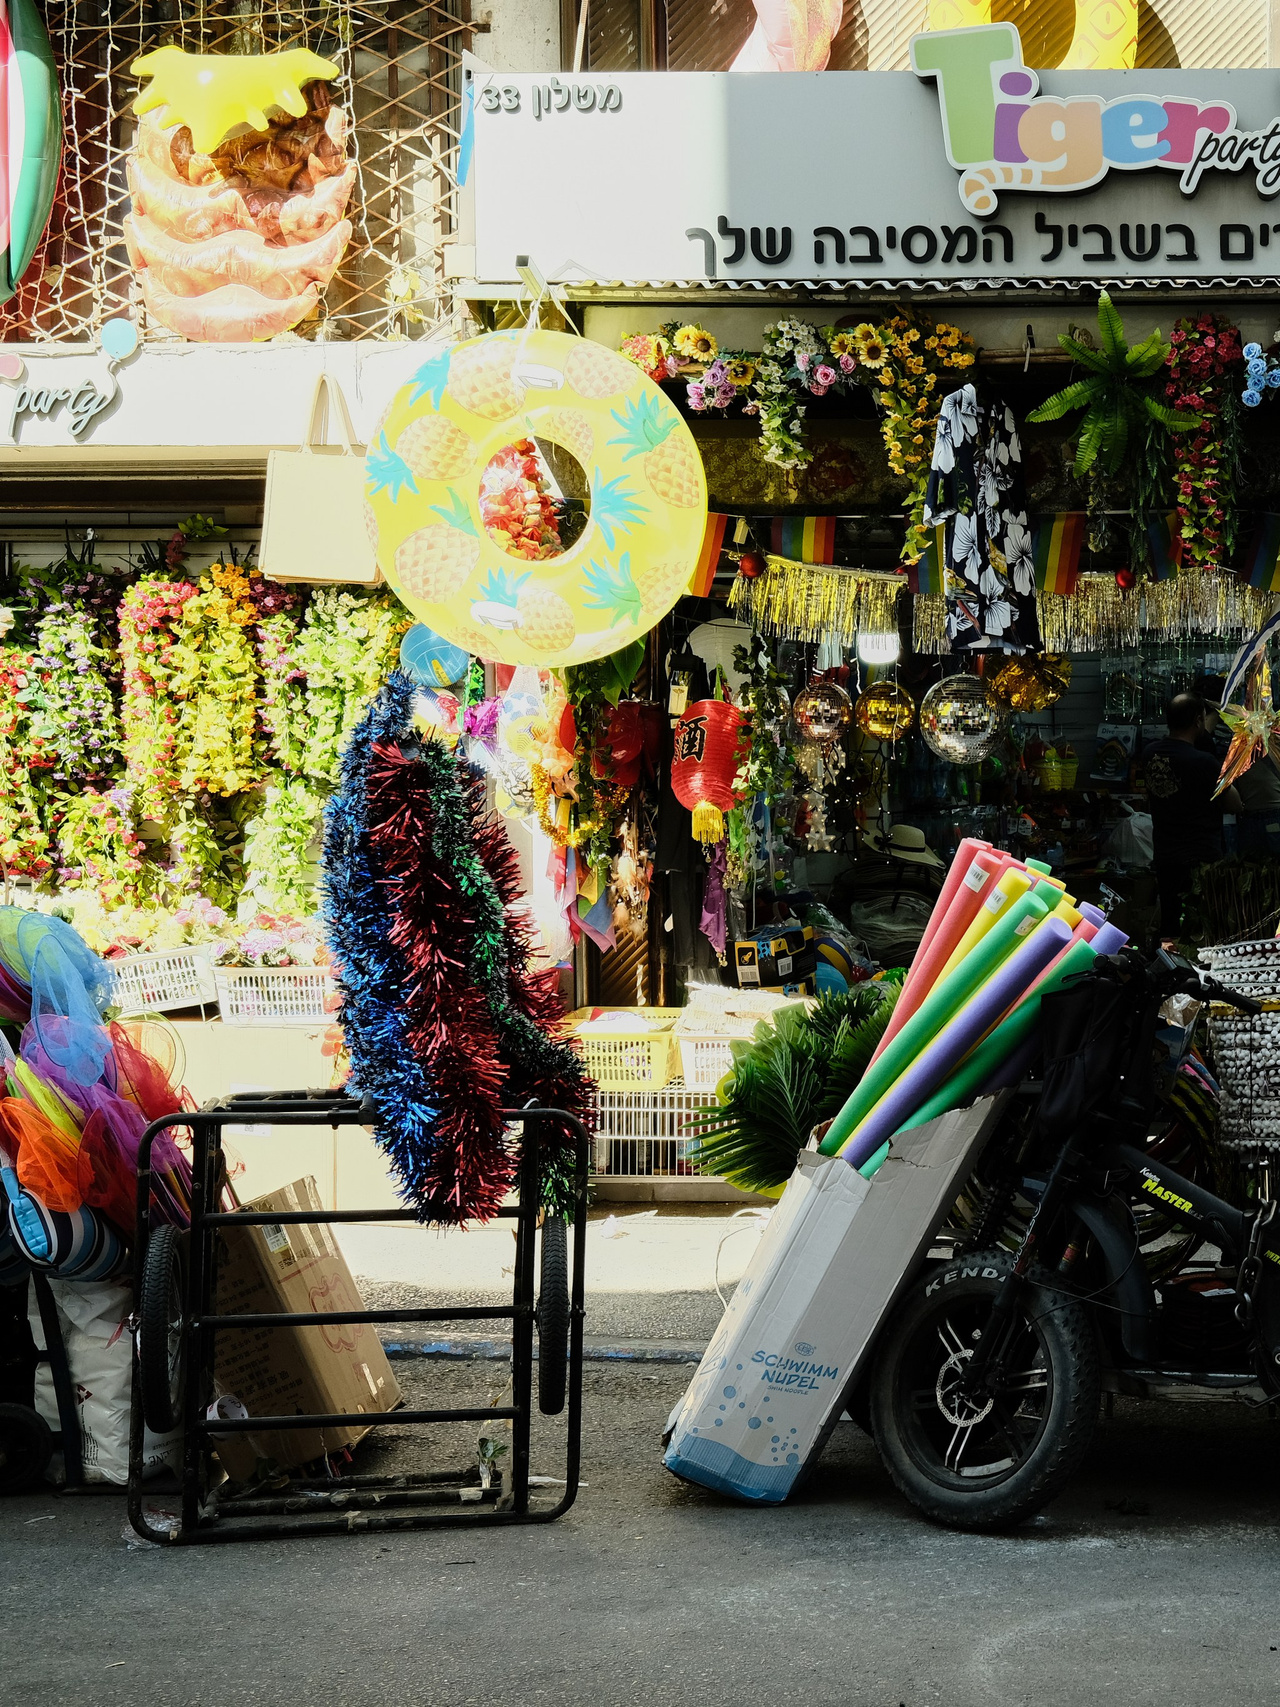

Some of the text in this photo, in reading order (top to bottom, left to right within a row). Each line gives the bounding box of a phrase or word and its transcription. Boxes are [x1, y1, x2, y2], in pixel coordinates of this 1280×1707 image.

[482, 77, 622, 118] מטלון 33
[912, 26, 1232, 188] Tiger
[684, 215, 793, 278] שלך
[813, 224, 1015, 266] המסיבה
[1034, 211, 1199, 264] בשביל
[8, 379, 110, 438] party
[1141, 1178, 1194, 1213] MASTER
[751, 1350, 839, 1380] SCHWIMM
[760, 1369, 820, 1390] NUDEL
